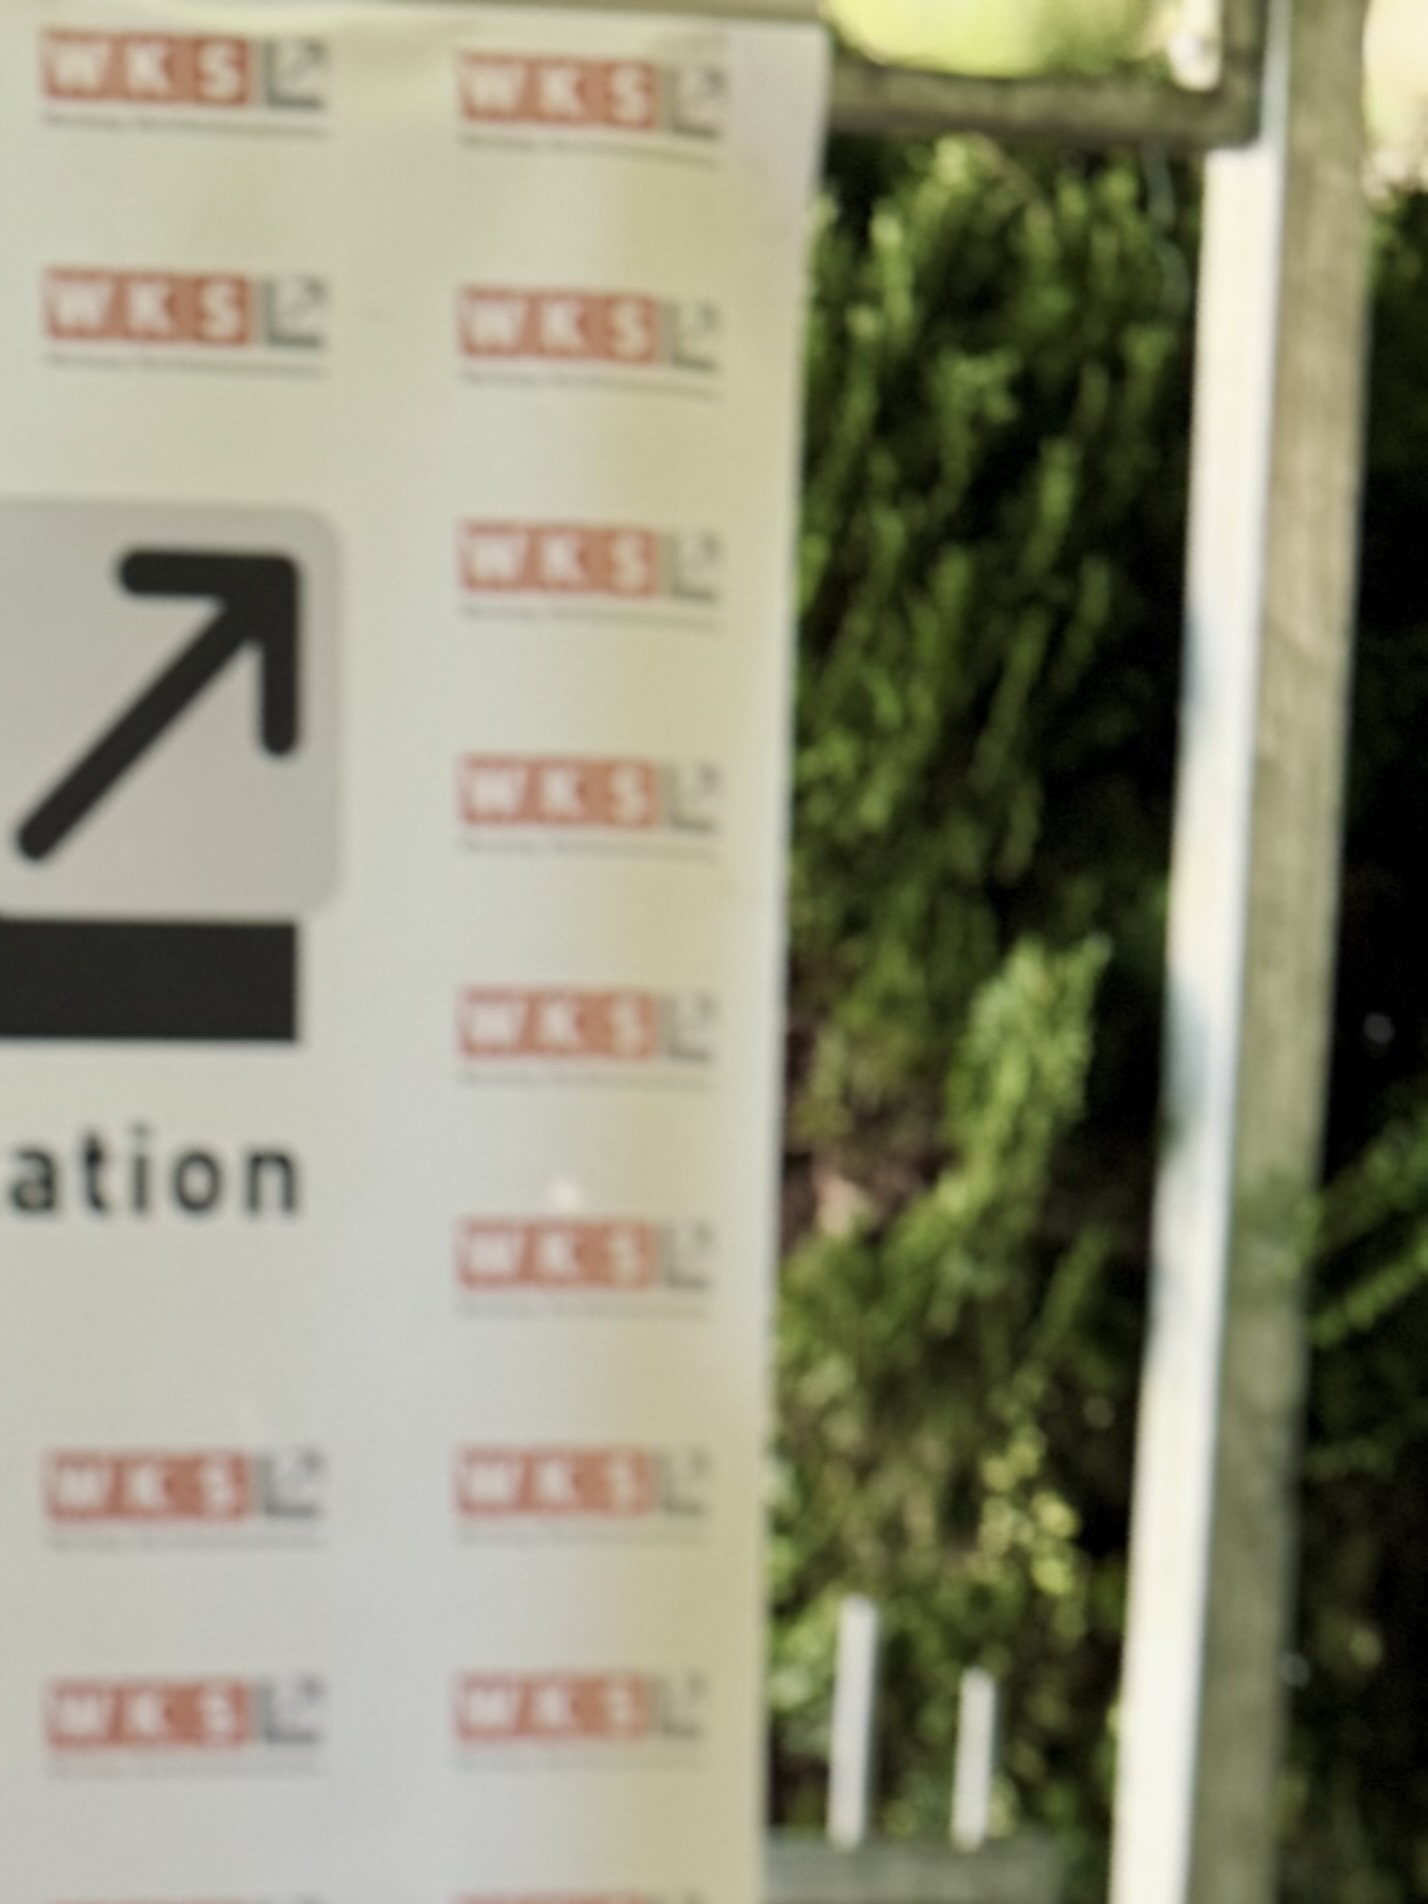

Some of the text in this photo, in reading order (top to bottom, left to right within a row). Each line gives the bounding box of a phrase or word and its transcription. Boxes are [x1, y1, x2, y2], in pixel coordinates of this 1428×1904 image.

[43, 38, 244, 99] WKS
[462, 61, 650, 124] WKS
[47, 276, 244, 339] WKS
[461, 296, 651, 359] WKS
[462, 530, 650, 591] WKS
[462, 764, 650, 822] WKS
[461, 997, 649, 1053] WKS
[459, 1227, 647, 1283] WKS
[48, 1461, 242, 1515] WKS
[459, 1455, 644, 1510] WKS
[48, 1688, 241, 1743] WKS
[458, 1681, 640, 1734] WKS
